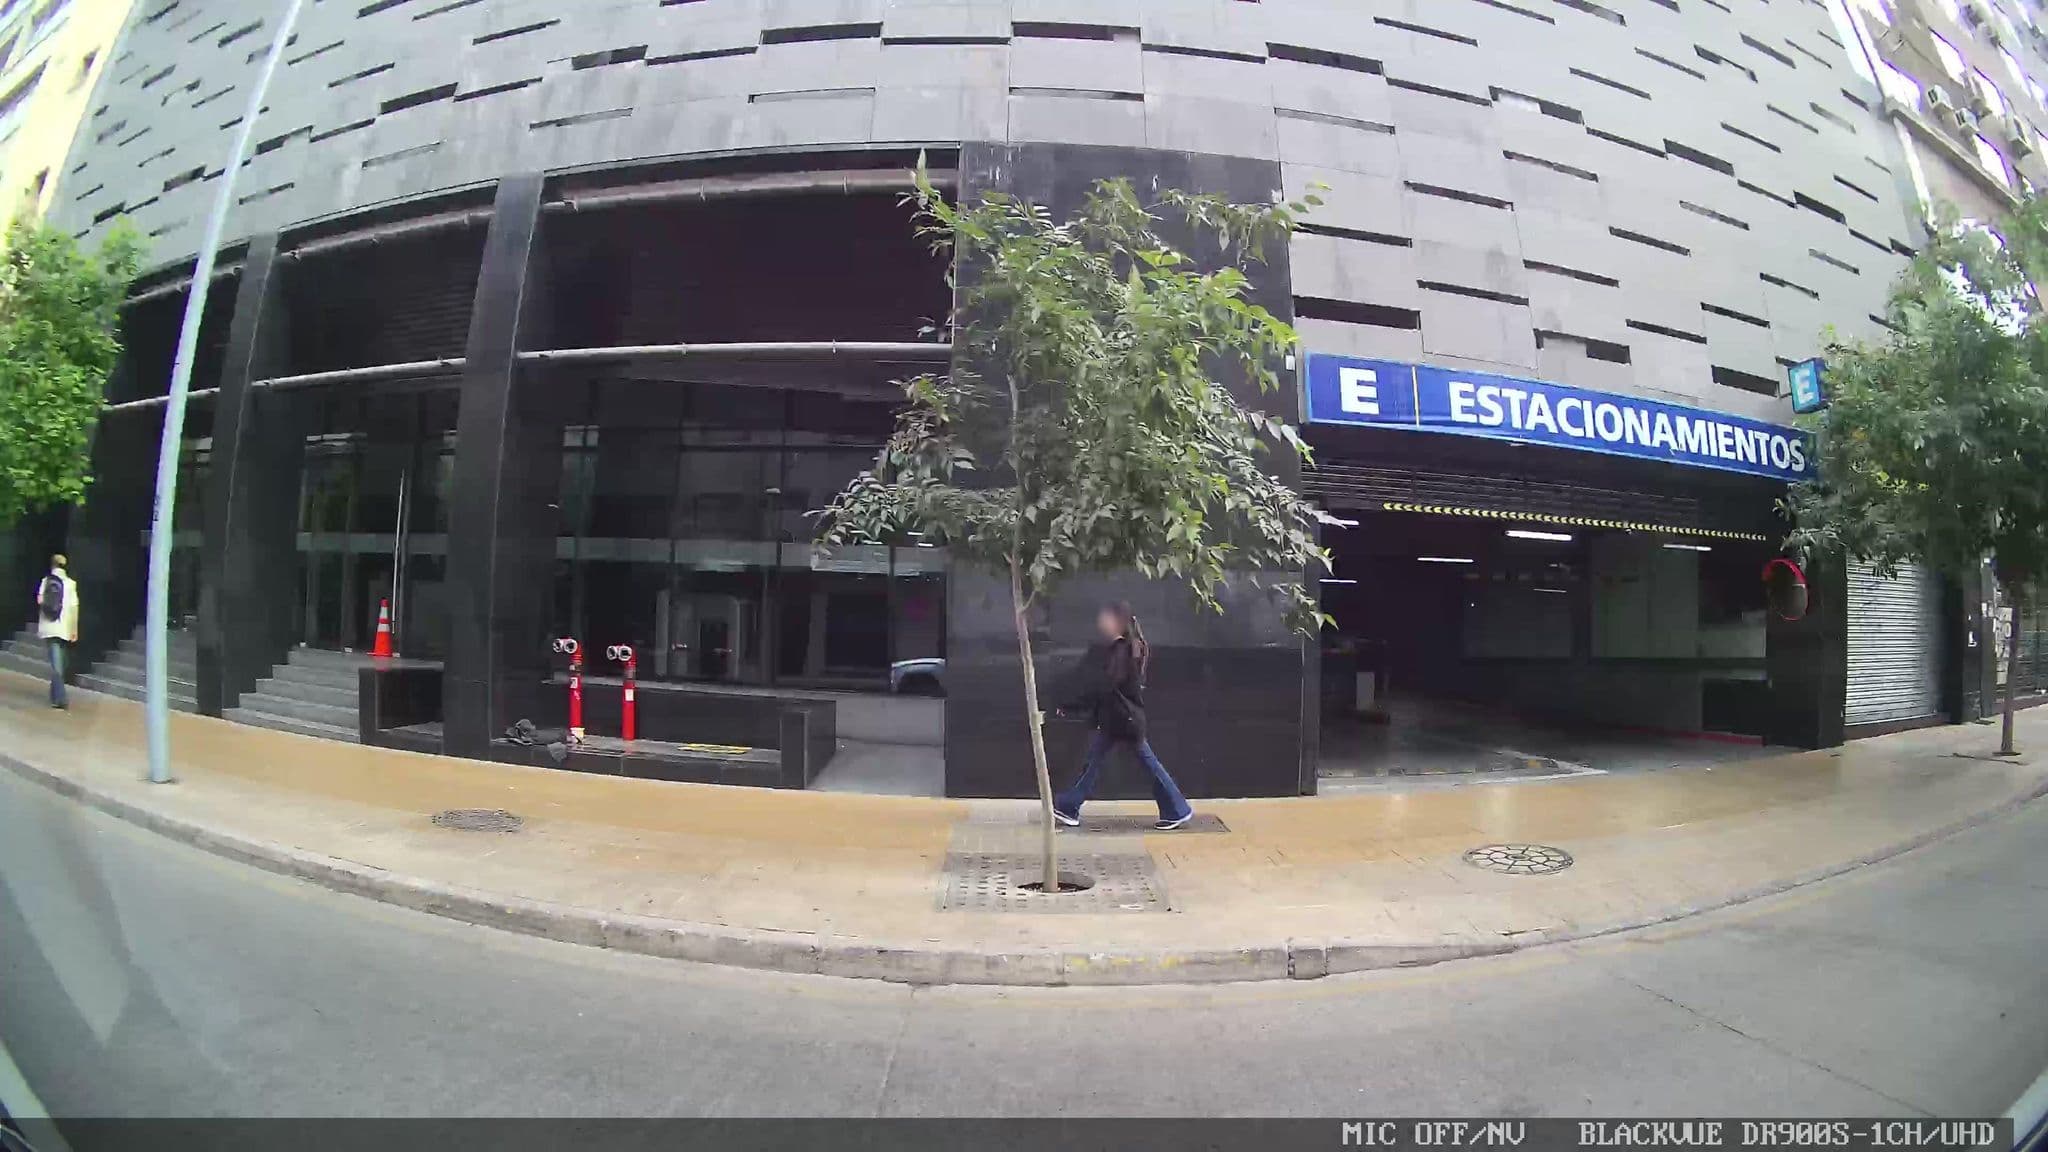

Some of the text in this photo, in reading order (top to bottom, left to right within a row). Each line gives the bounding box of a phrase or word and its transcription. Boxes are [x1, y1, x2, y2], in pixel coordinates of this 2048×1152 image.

[1339, 367, 1805, 472] E ESTACIONAMIENTOS
[1795, 367, 1815, 404] E
